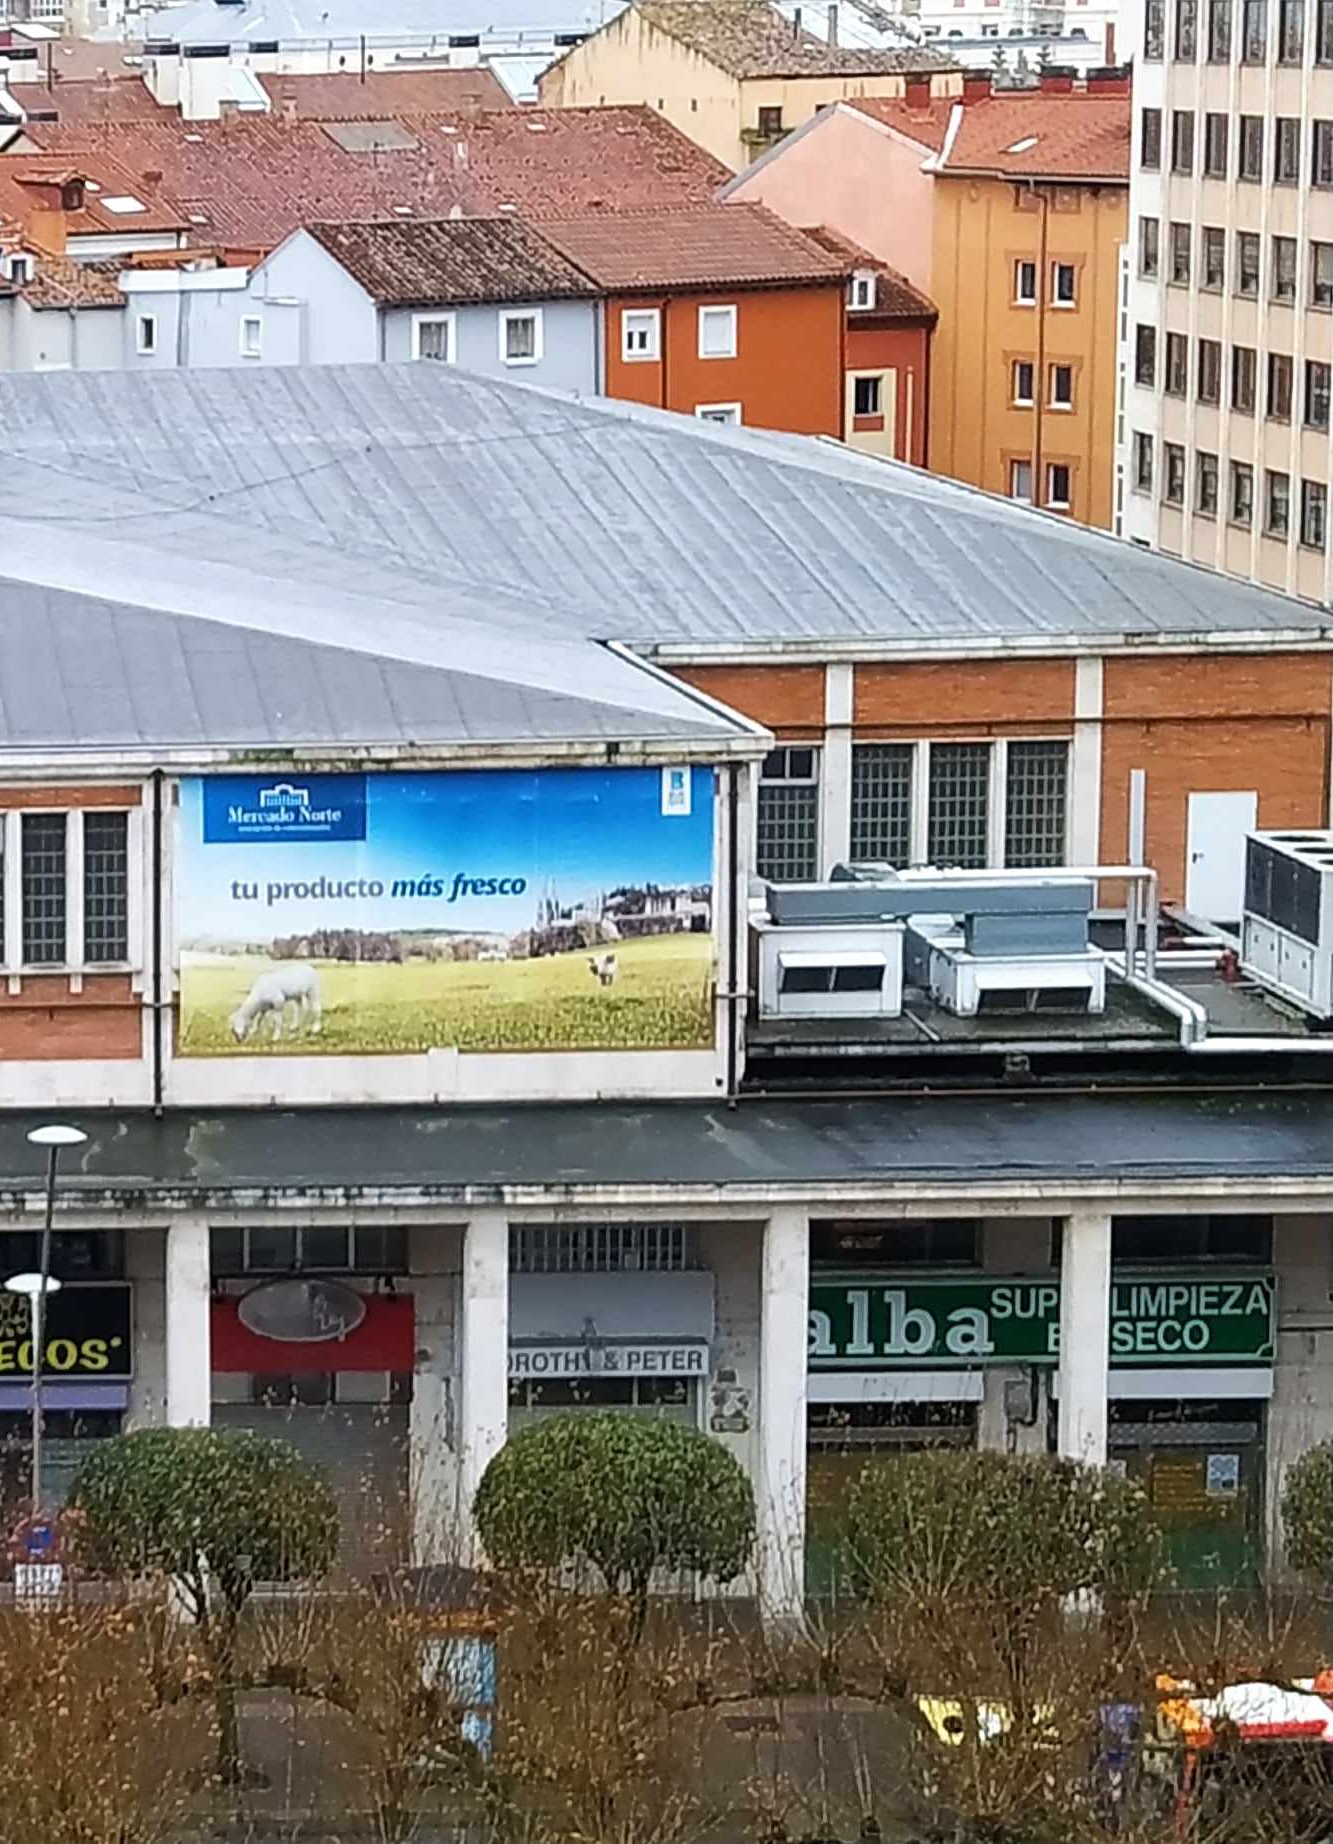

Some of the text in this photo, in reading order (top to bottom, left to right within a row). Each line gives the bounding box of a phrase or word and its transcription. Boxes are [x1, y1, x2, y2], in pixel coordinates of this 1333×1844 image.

[227, 805, 342, 824] Mercado Norte
[231, 872, 527, 907] tu producto más fresco
[1112, 1319, 1210, 1352] SECO
[627, 1350, 703, 1370] PETER
